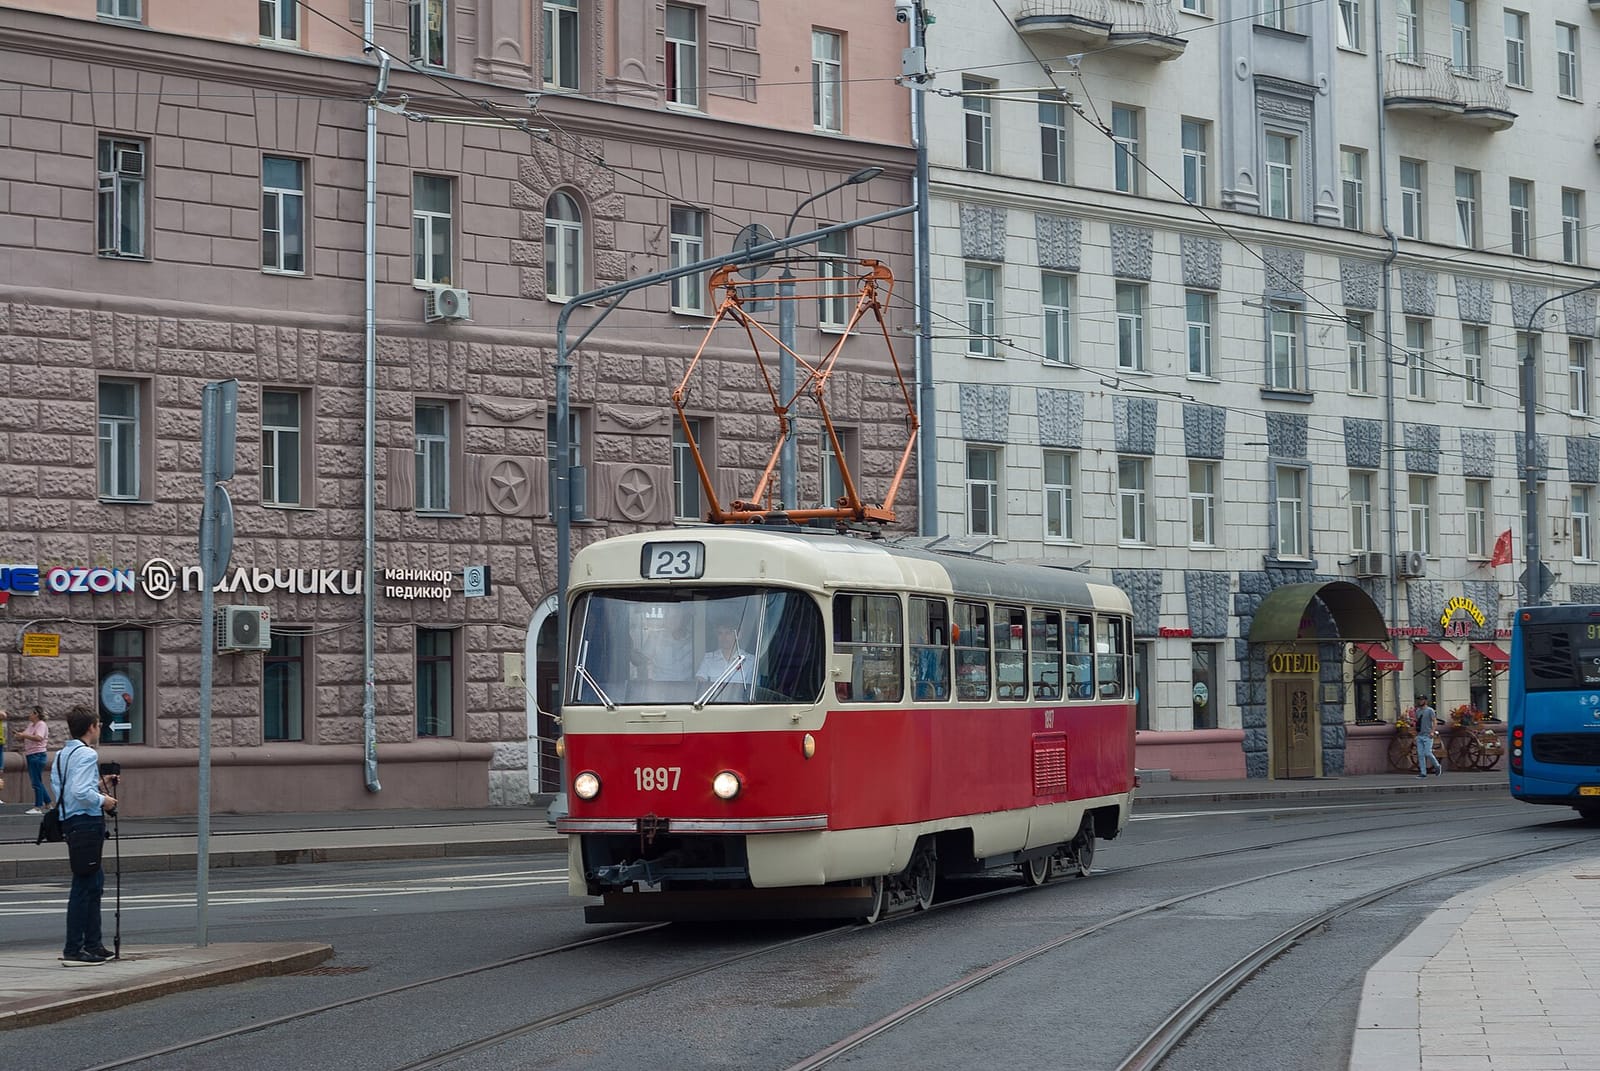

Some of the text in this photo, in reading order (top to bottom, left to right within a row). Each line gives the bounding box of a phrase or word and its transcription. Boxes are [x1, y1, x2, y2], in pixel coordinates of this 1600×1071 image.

[656, 551, 691, 574] 23
[47, 567, 135, 593] OZON
[385, 568, 452, 585] маникюр
[386, 586, 452, 602] педикюр
[1445, 621, 1473, 637] БАР
[1272, 653, 1320, 673] ОТЕЛЬ
[634, 767, 681, 791] 1897
